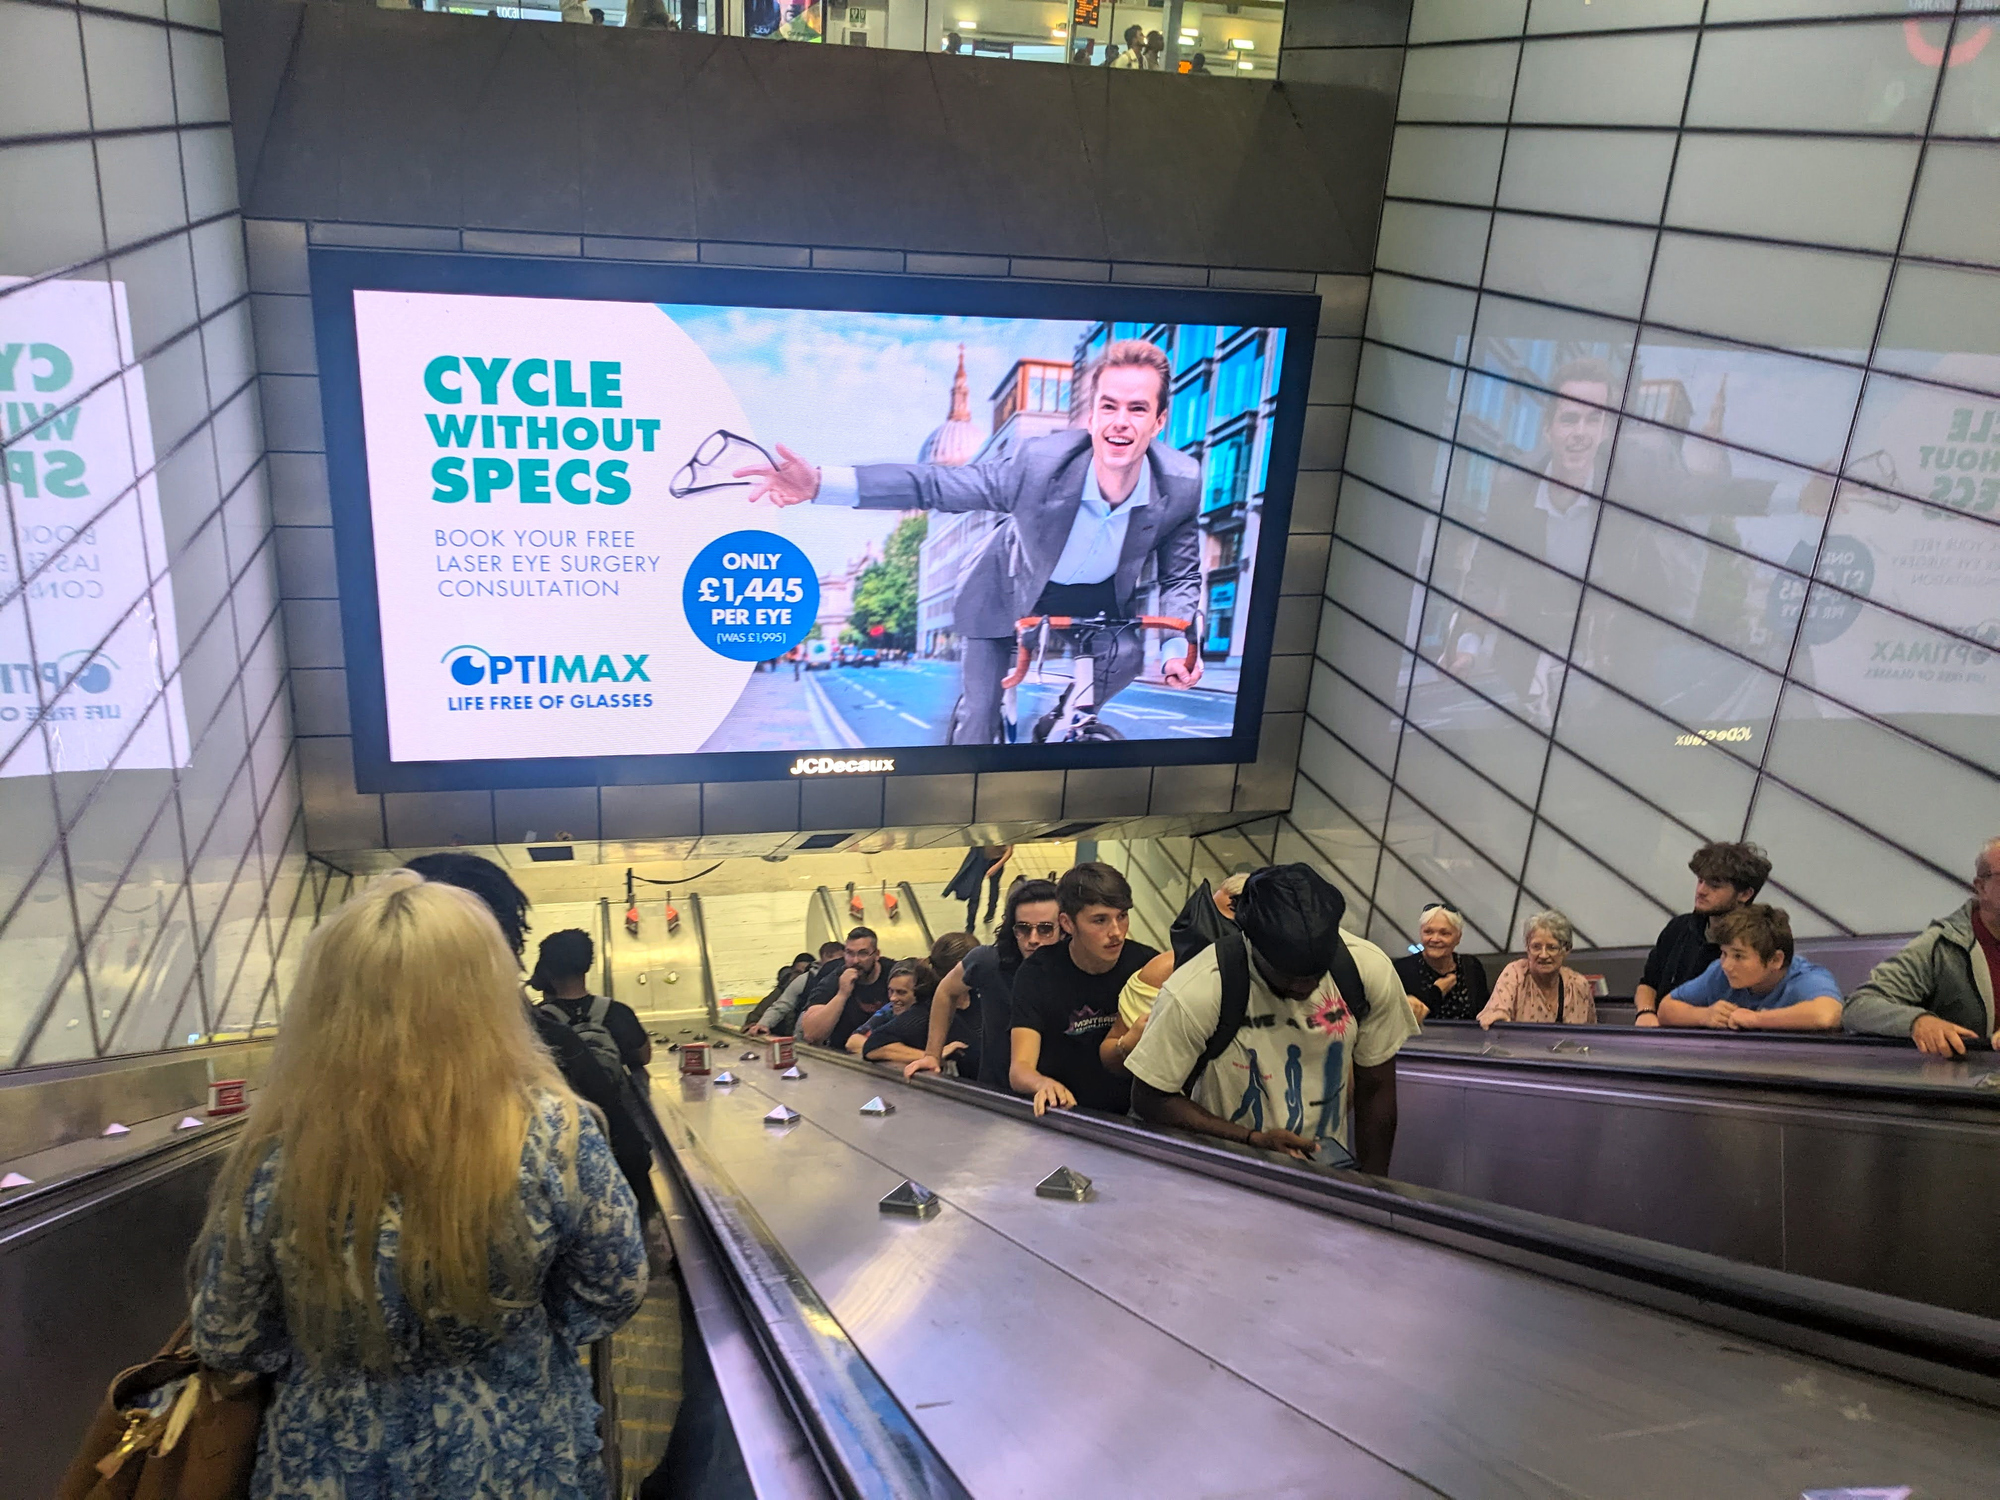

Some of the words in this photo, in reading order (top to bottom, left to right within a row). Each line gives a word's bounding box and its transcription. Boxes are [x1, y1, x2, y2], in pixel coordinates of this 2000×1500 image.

[424, 355, 622, 408] CYCLE
[424, 413, 661, 452] WITHOUT
[431, 456, 632, 505] SPECS
[435, 529, 505, 547] BOOK
[513, 529, 577, 547] YOUR
[587, 530, 635, 547] FREE
[436, 554, 502, 572] LASER
[512, 555, 550, 572] EYE
[561, 555, 661, 572] SURGERY
[722, 552, 782, 570] ONLY
[438, 579, 619, 598] CONSULTATION
[698, 577, 804, 606] £1,445
[711, 608, 751, 625] PER
[755, 608, 792, 625] EYE
[716, 632, 747, 645] (WAS
[748, 632, 787, 645] £1,995)
[441, 645, 651, 686] OPTIMAX
[448, 697, 484, 711] LIFE
[490, 696, 533, 710] FREE
[539, 695, 564, 709] OF
[570, 693, 653, 708] GLASSES
[790, 758, 895, 775] JCDecaux
